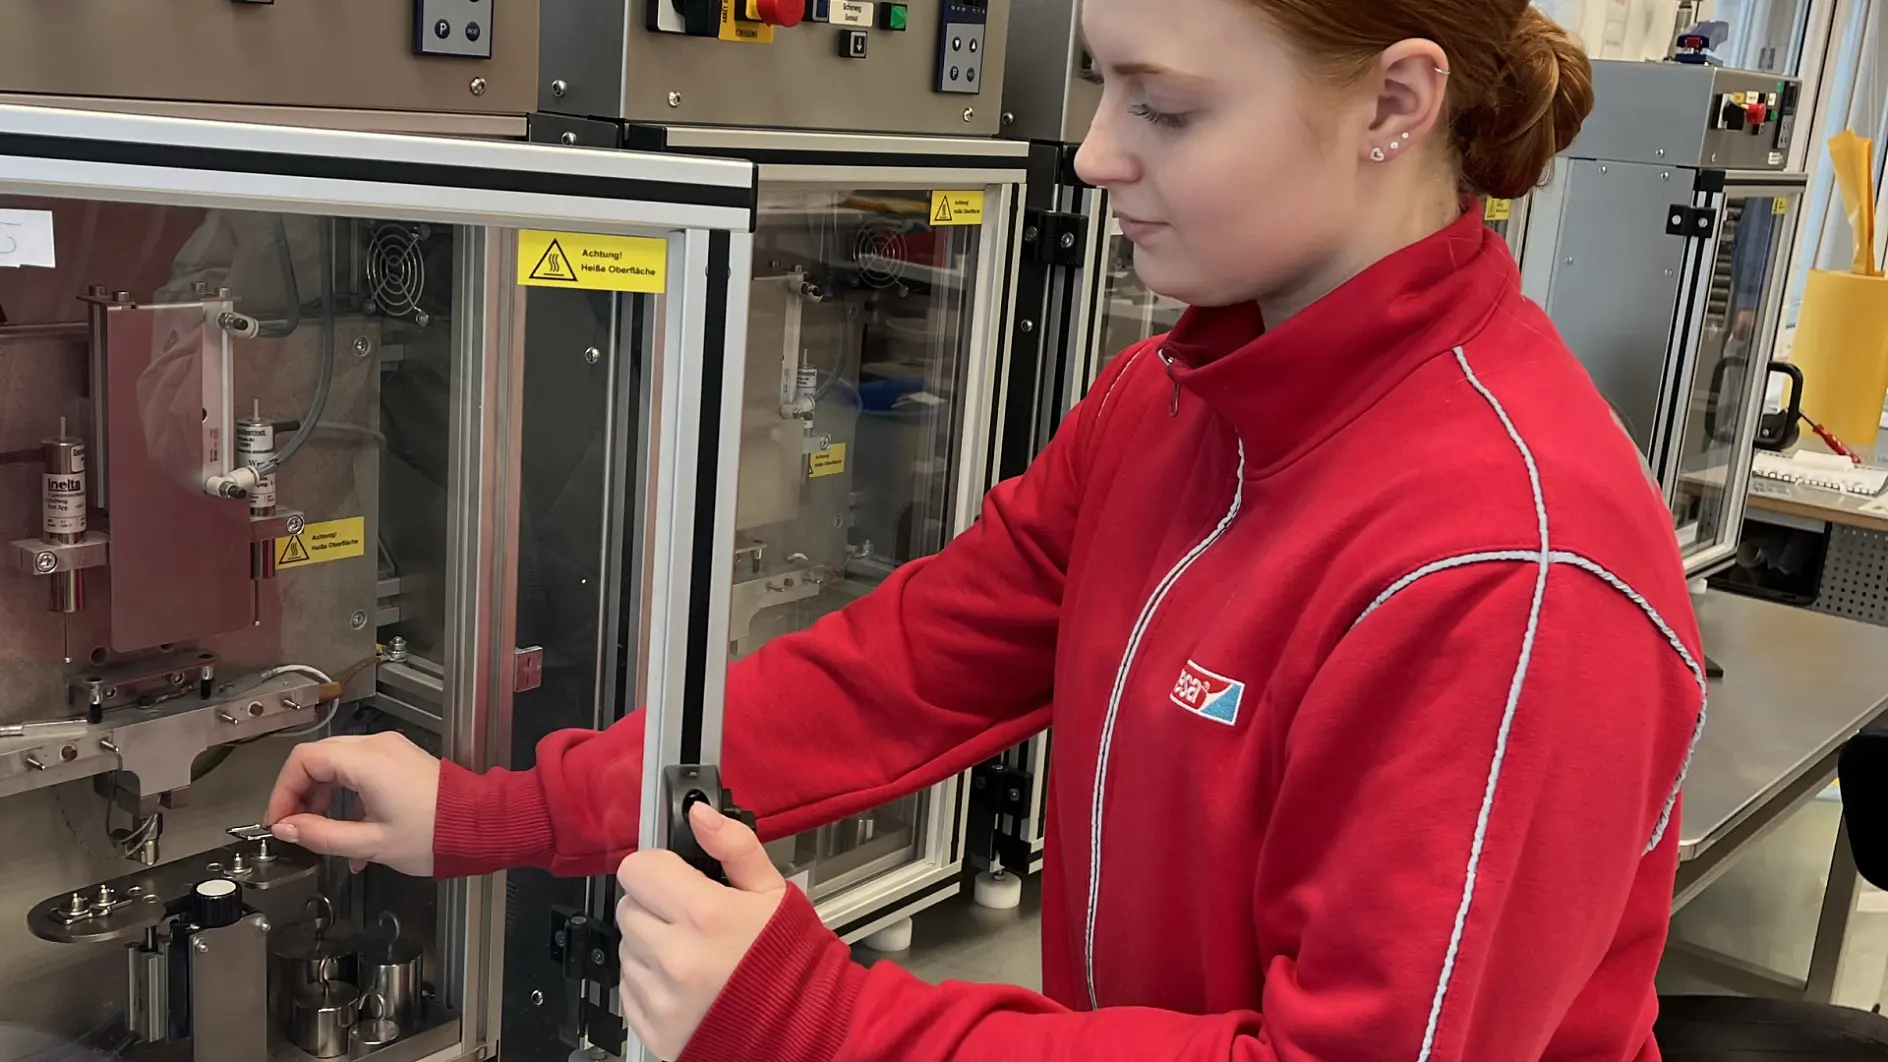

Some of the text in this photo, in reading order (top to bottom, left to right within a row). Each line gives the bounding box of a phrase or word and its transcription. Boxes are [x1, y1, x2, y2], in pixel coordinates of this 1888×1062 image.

[440, 22, 447, 35] P
[582, 249, 622, 260] Achtung!
[581, 264, 656, 276] Heiße Oberfläche
